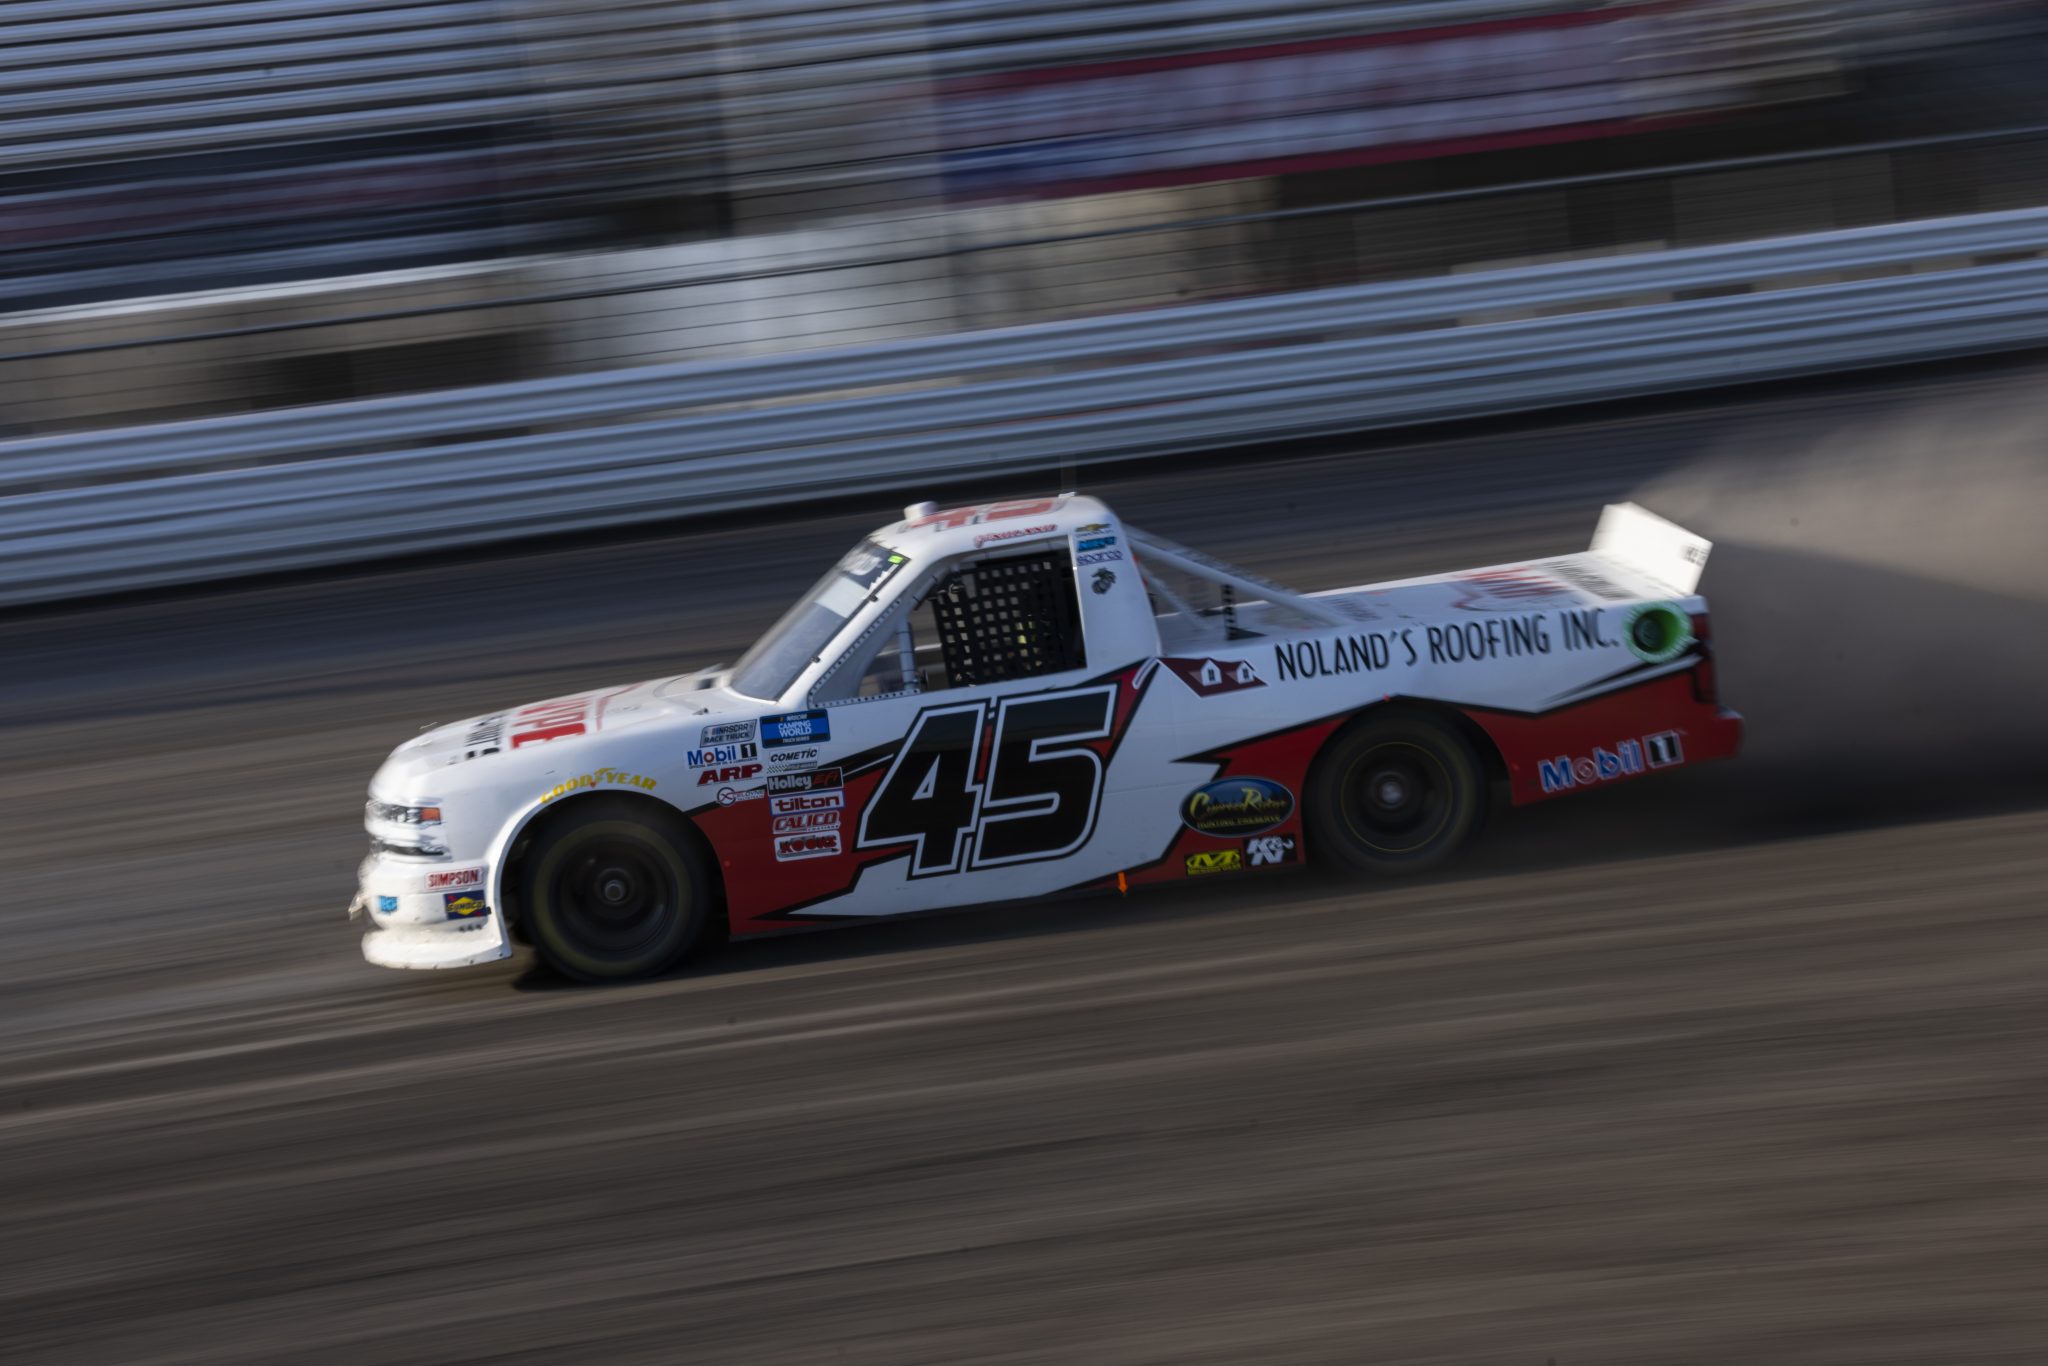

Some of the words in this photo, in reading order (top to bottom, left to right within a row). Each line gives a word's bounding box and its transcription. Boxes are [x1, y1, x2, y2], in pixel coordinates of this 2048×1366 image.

[1274, 630, 1418, 681] NOLAND'S
[1430, 615, 1551, 664] ROOFING
[1559, 606, 1620, 651] INC.
[777, 719, 812, 730] CAMPING
[779, 727, 813, 738] WORLD
[704, 734, 724, 744] RACE
[726, 731, 750, 742] TRUCK
[687, 745, 737, 766] Mobil
[697, 763, 763, 785] ARP
[1537, 739, 1645, 794] Mobil
[539, 767, 657, 804] GOODYEAR
[768, 775, 812, 792] Holley
[856, 683, 1118, 879] 45
[775, 796, 840, 812] tilton
[774, 812, 838, 831] CALICO
[427, 869, 479, 888] SIMPSON
